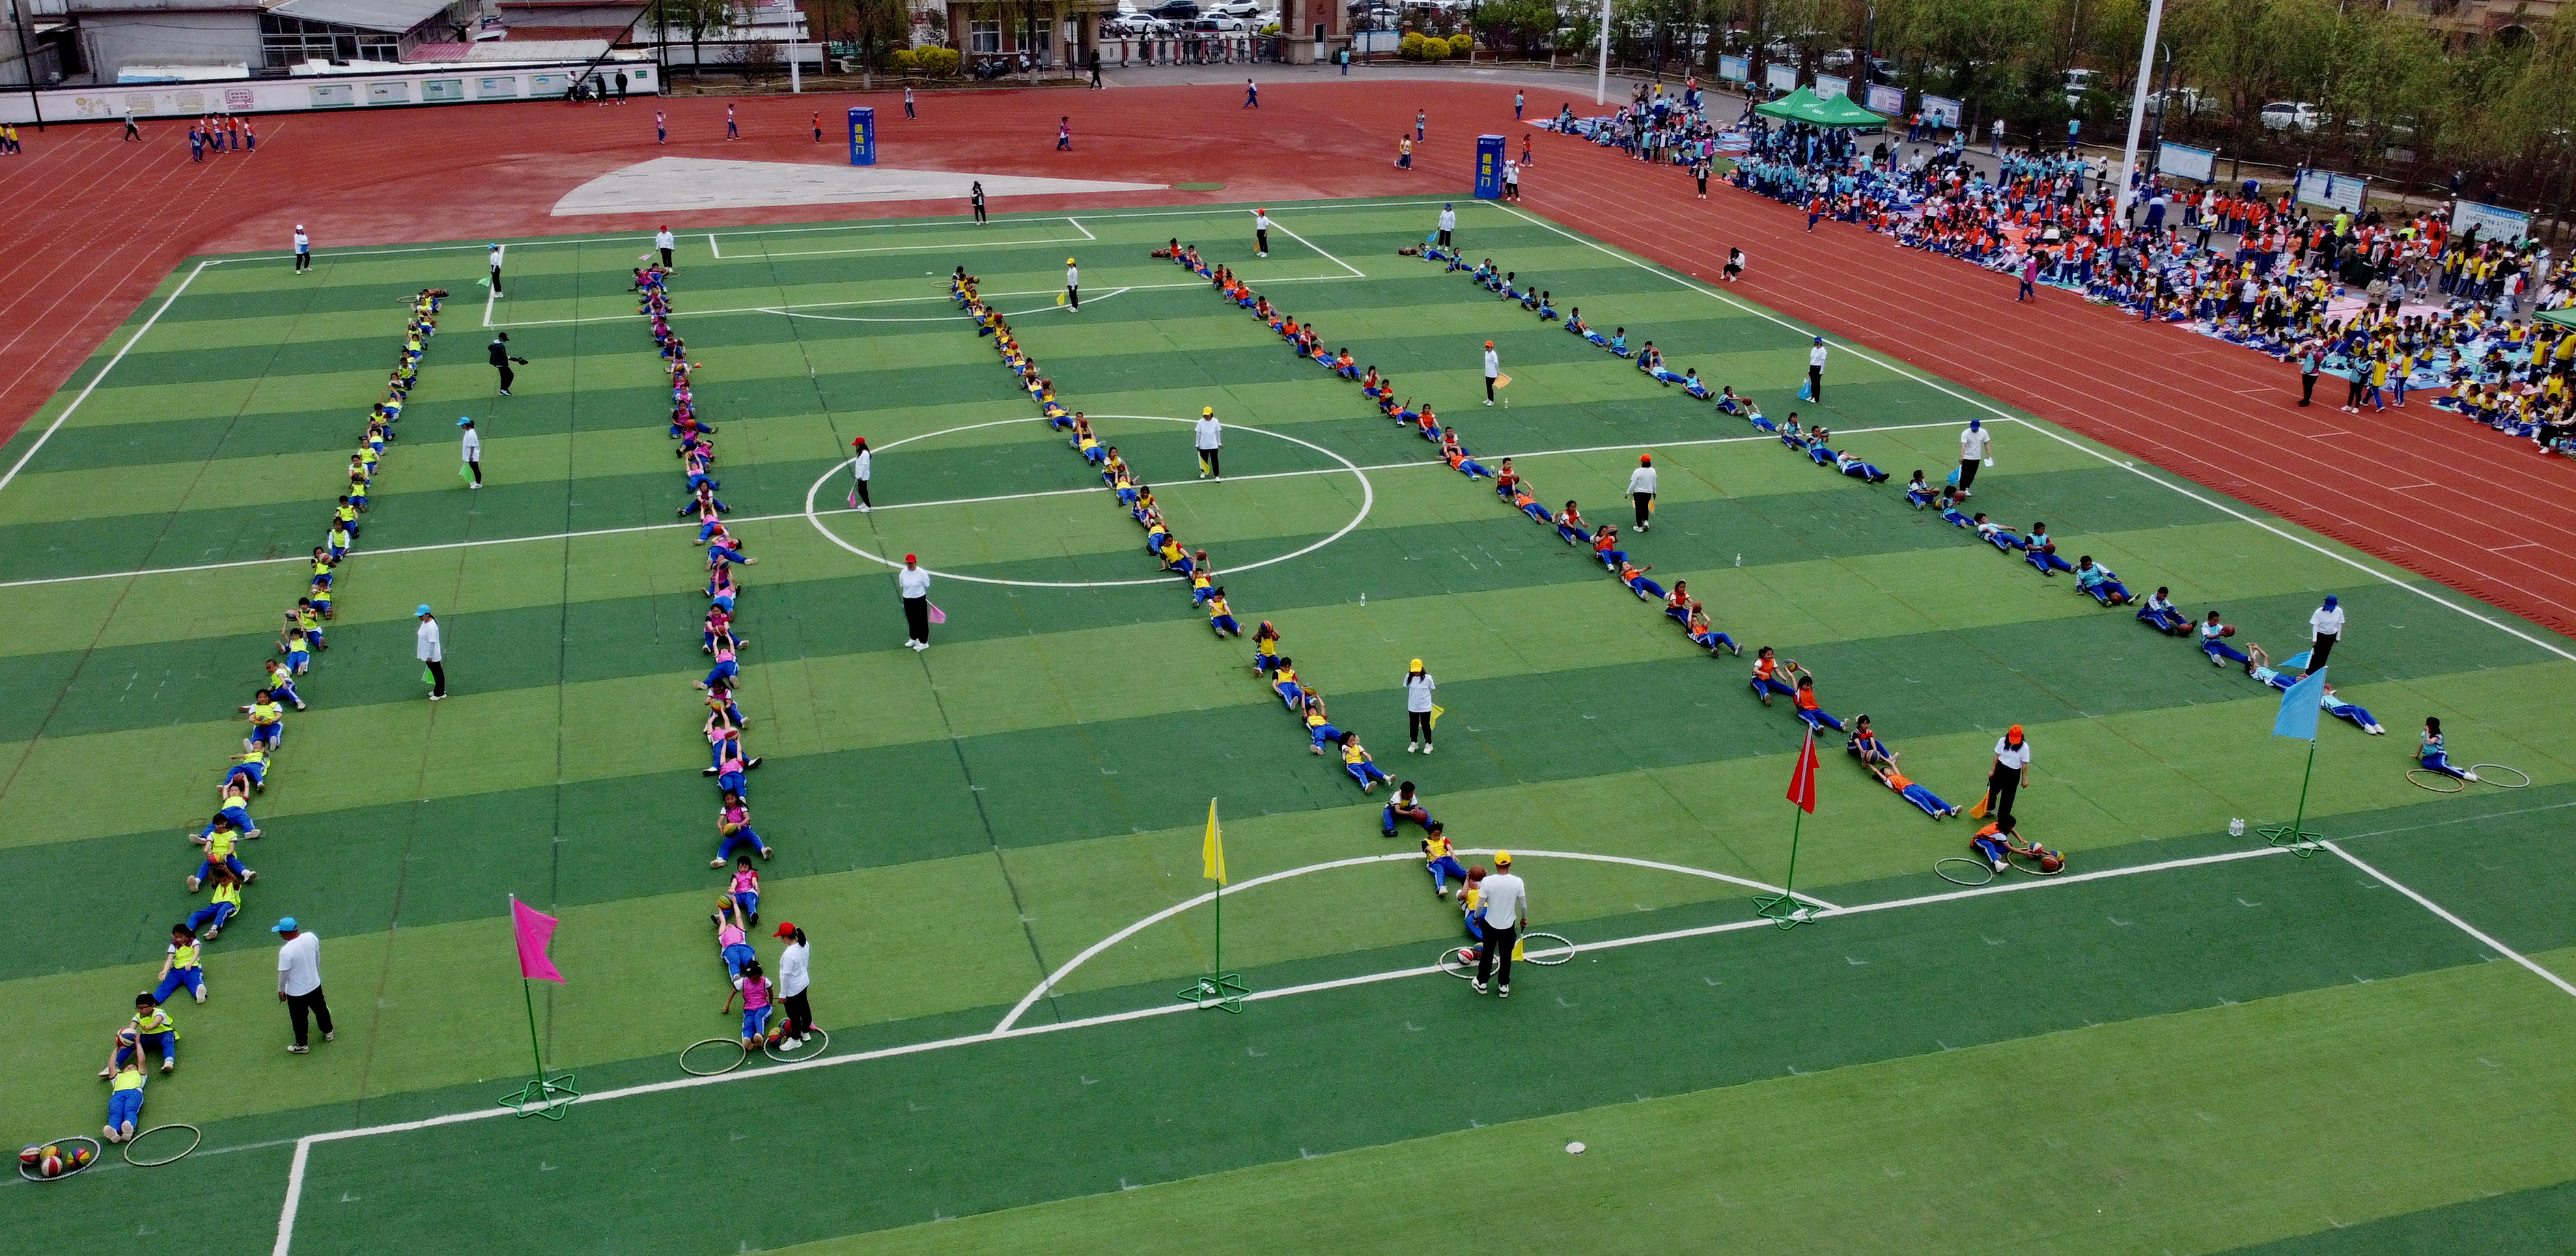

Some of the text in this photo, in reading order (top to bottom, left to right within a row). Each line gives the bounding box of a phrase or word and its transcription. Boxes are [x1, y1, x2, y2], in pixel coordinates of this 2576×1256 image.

[854, 124, 865, 155] 退场门
[1481, 153, 1492, 187] 退场门
